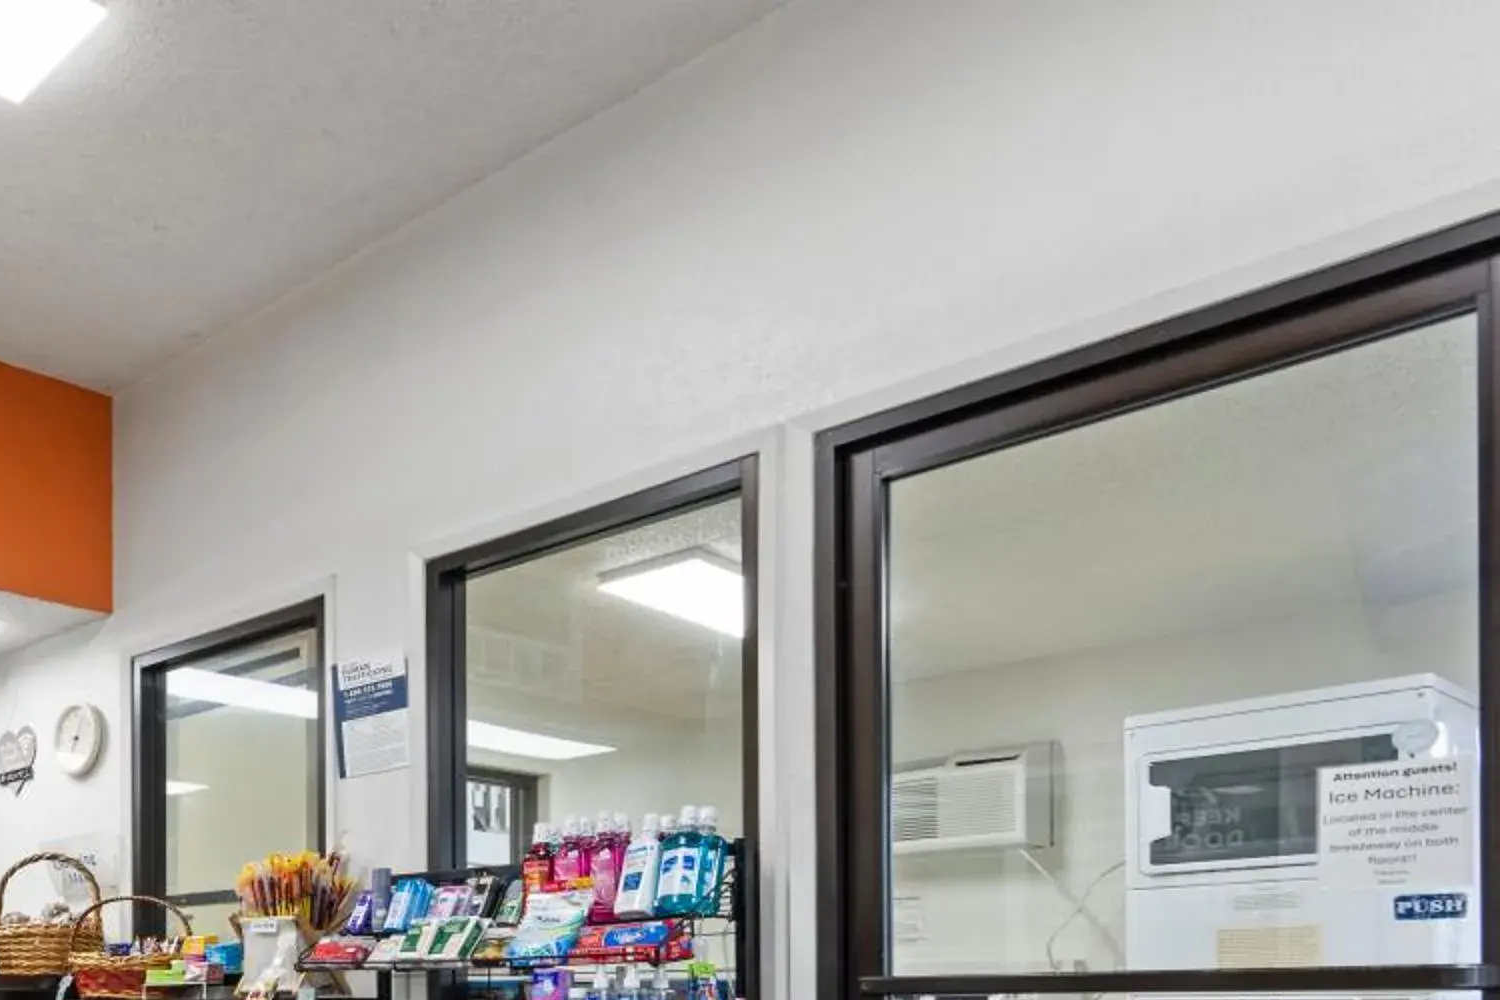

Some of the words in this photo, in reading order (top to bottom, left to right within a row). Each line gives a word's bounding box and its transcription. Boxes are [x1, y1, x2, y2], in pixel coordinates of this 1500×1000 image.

[1332, 767, 1400, 782] Attention
[1402, 761, 1458, 778] guests!
[1328, 790, 1359, 805] Ice
[1363, 783, 1461, 801] Machine:
[1322, 810, 1377, 826] Located
[1379, 809, 1392, 820] in
[1394, 807, 1417, 819] the
[1420, 805, 1469, 818] center
[1404, 838, 1422, 849] on
[1425, 835, 1460, 849] both
[1394, 897, 1465, 915] PUSH
